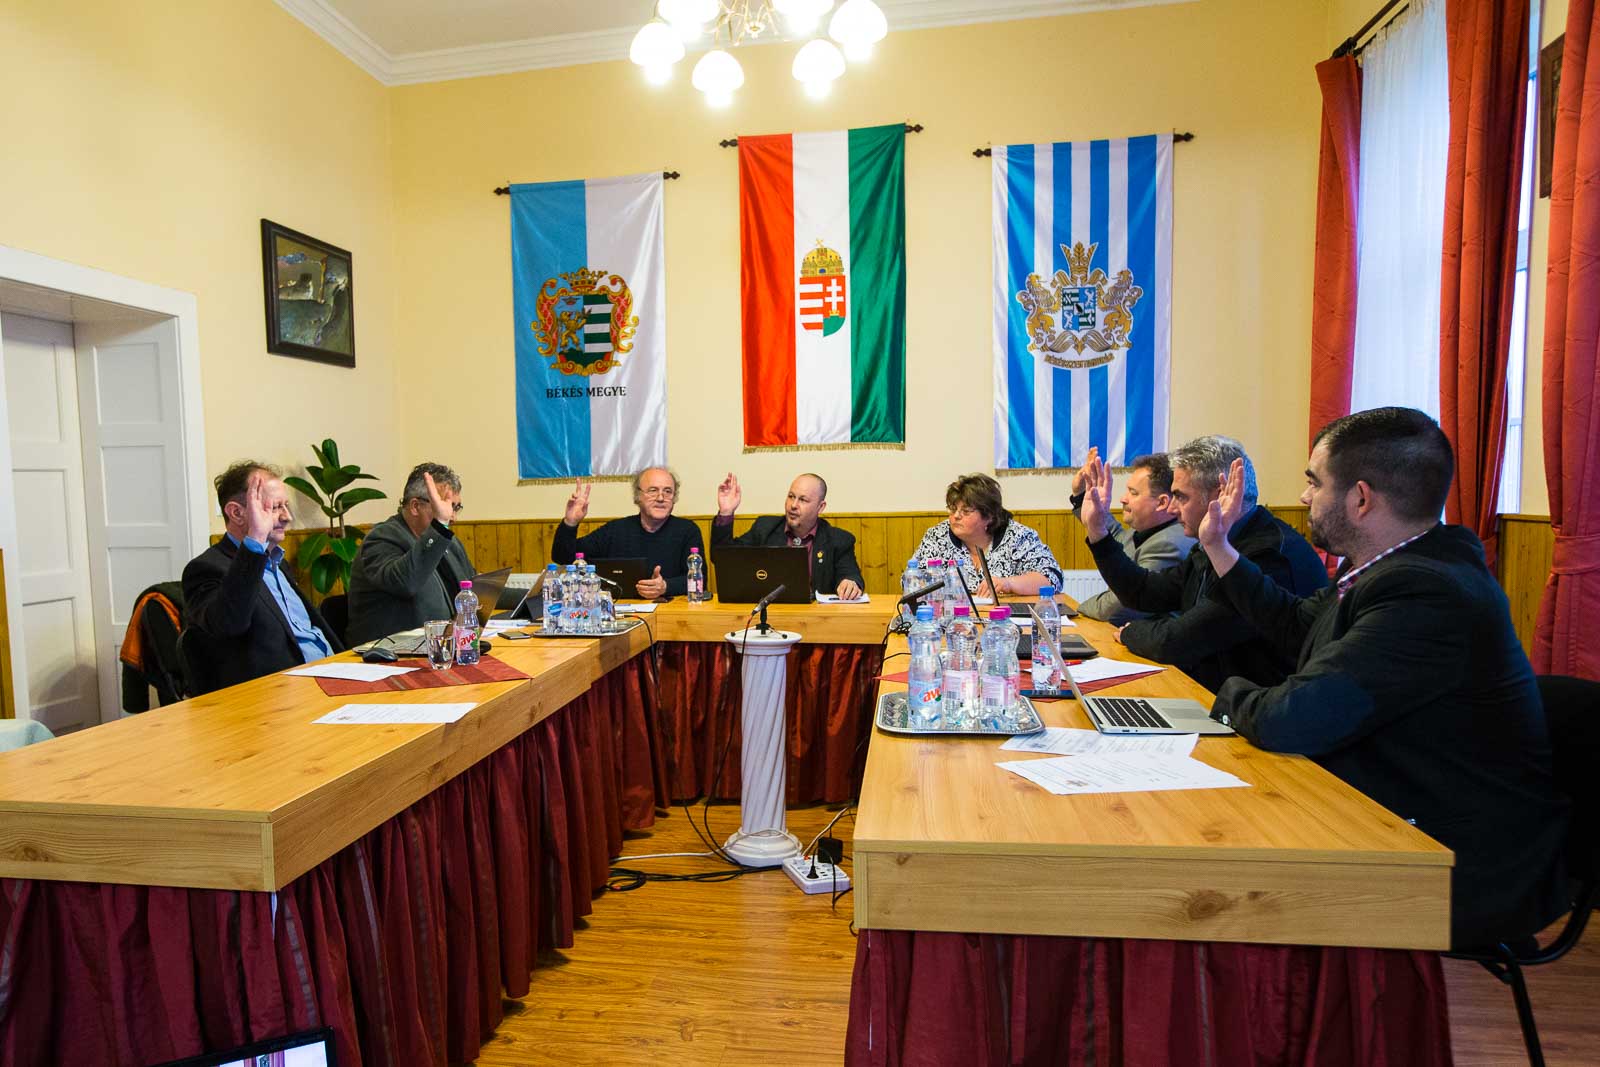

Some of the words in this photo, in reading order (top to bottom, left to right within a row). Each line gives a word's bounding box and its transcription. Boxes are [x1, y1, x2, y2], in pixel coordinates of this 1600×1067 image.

[546, 385, 583, 398] BÉKÉS
[586, 386, 626, 397] MEGYE
[460, 632, 476, 646] ave
